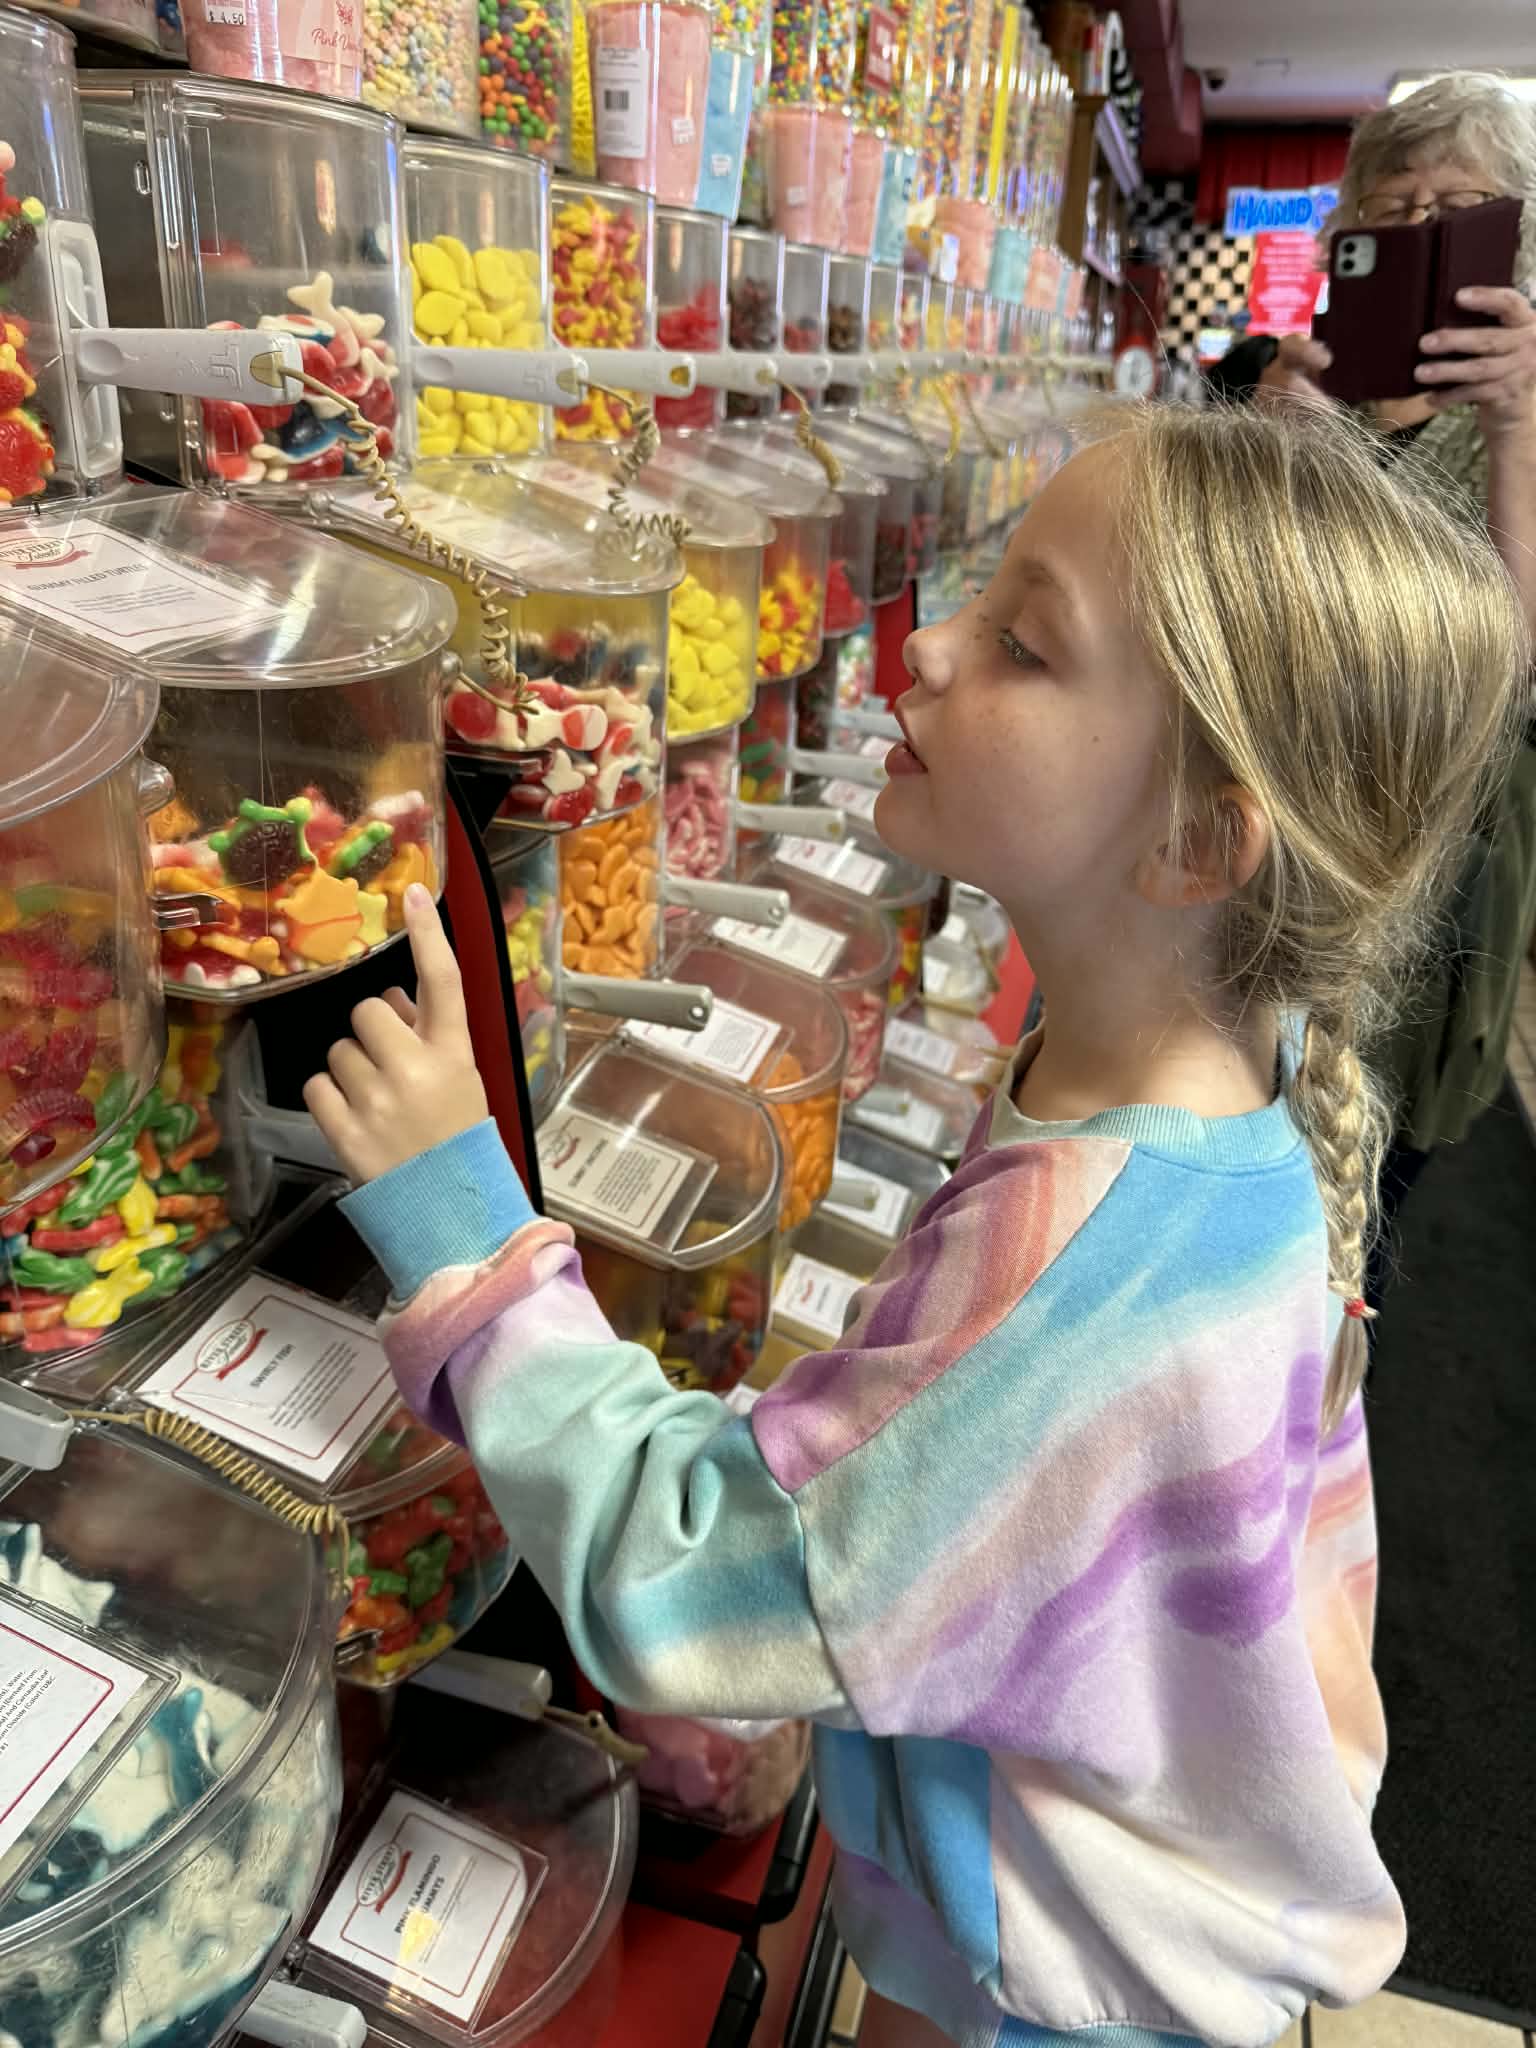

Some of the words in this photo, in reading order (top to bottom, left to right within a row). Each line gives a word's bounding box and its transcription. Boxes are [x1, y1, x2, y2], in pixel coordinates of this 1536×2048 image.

[1233, 195, 1313, 230] HAND
[71, 572, 106, 584] FILLED
[250, 1360, 279, 1388] SWIRLY
[409, 1854, 441, 1906] FLAMINGO
